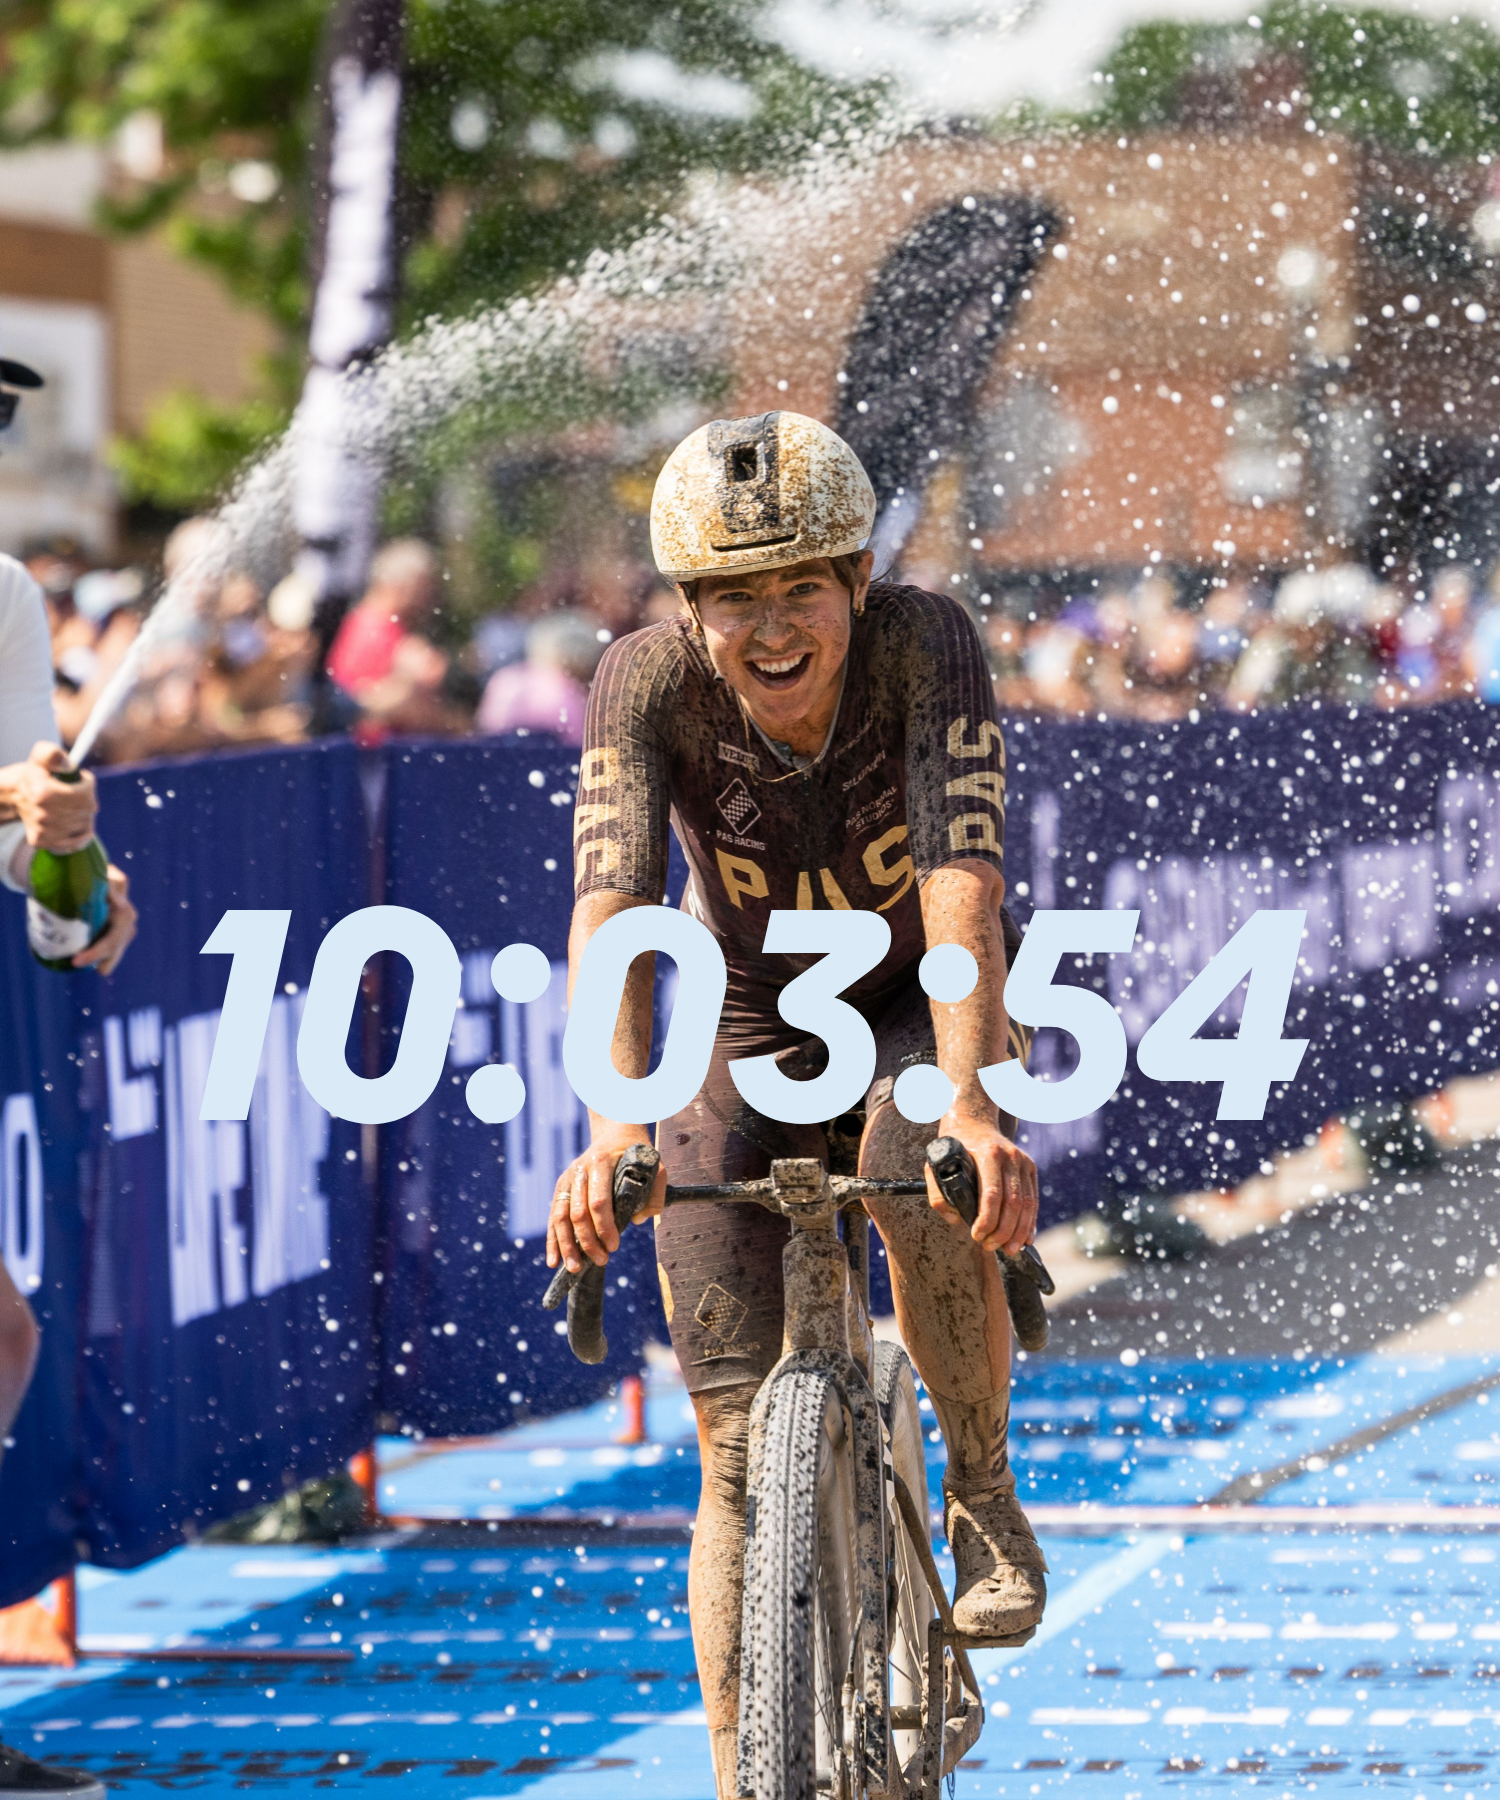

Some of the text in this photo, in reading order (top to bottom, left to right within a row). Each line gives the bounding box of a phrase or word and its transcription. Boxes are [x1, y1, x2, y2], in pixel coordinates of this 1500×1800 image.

[845, 786, 898, 828] PAS NORMAL
[946, 714, 1006, 860] PAS
[573, 747, 621, 890] PAS
[855, 800, 892, 830] STUDIOS
[716, 829, 766, 851] PAS RACING
